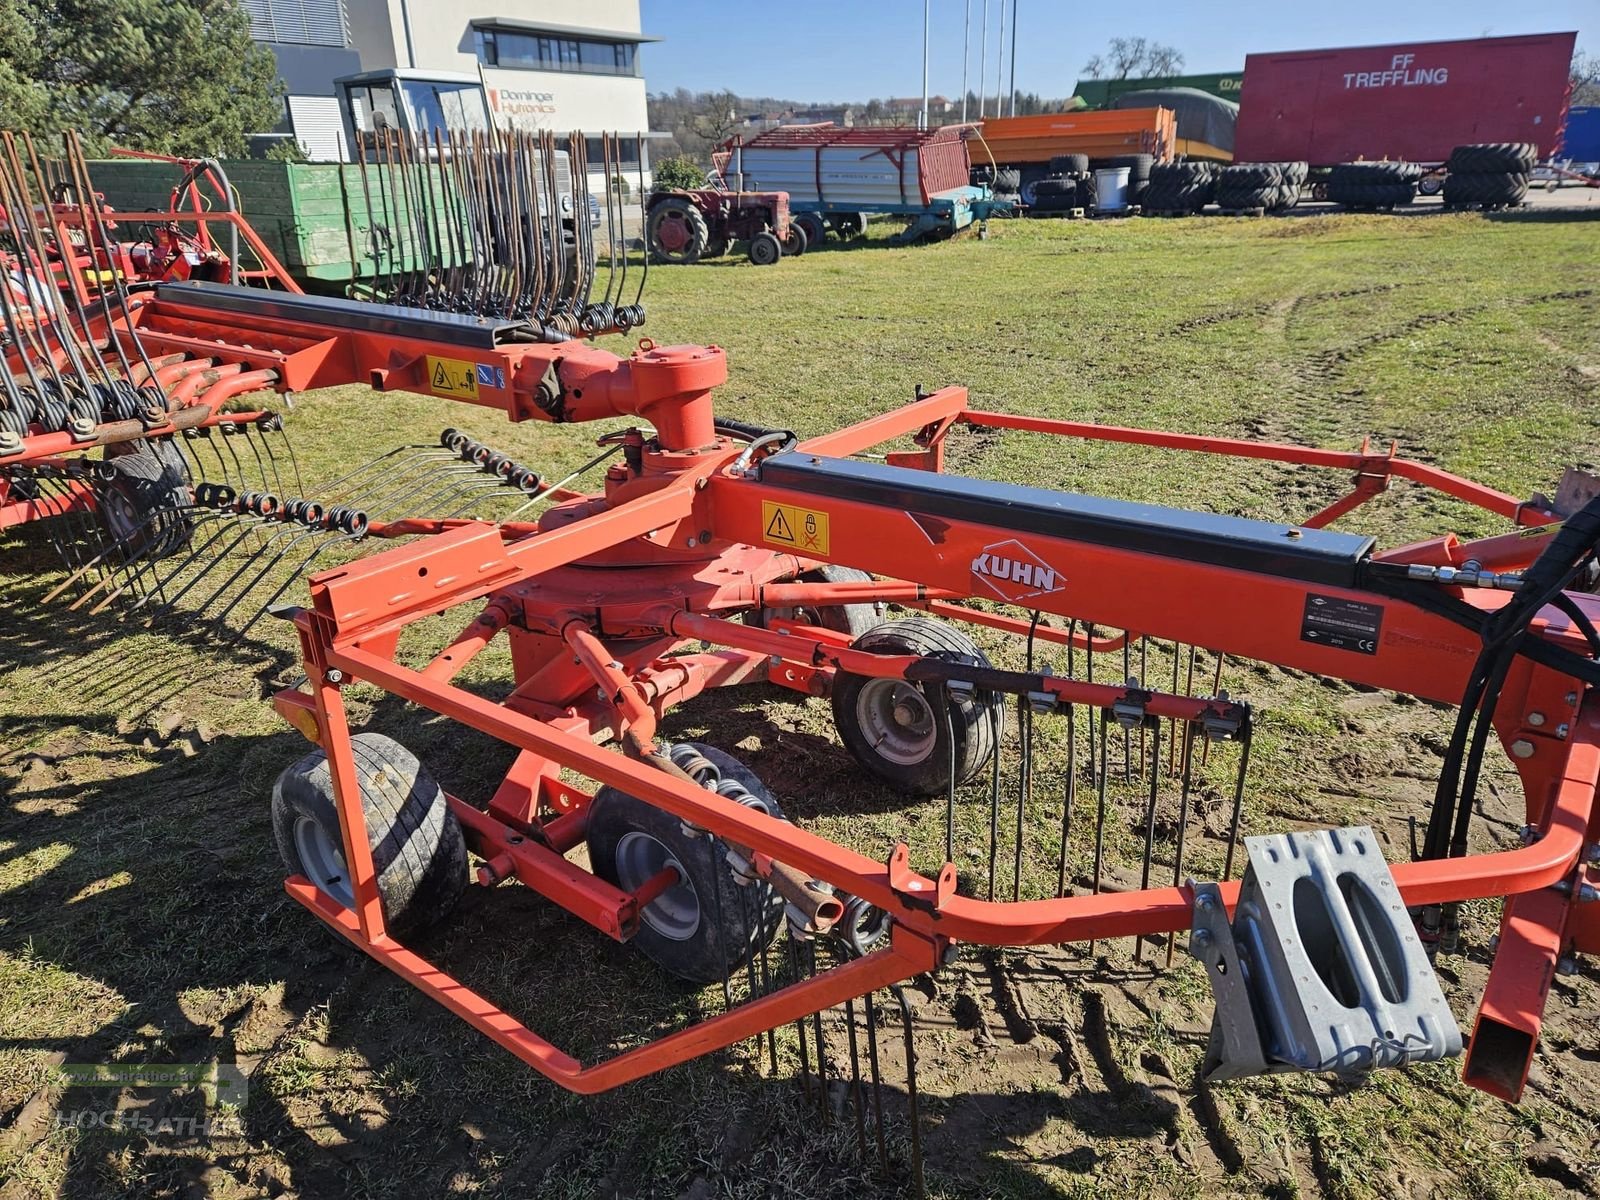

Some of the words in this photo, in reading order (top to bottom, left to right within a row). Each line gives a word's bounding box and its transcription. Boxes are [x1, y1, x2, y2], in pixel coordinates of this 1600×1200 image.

[1391, 53, 1415, 69] FF
[1343, 67, 1448, 89] TREFFLING
[971, 553, 1055, 591] KUHN
